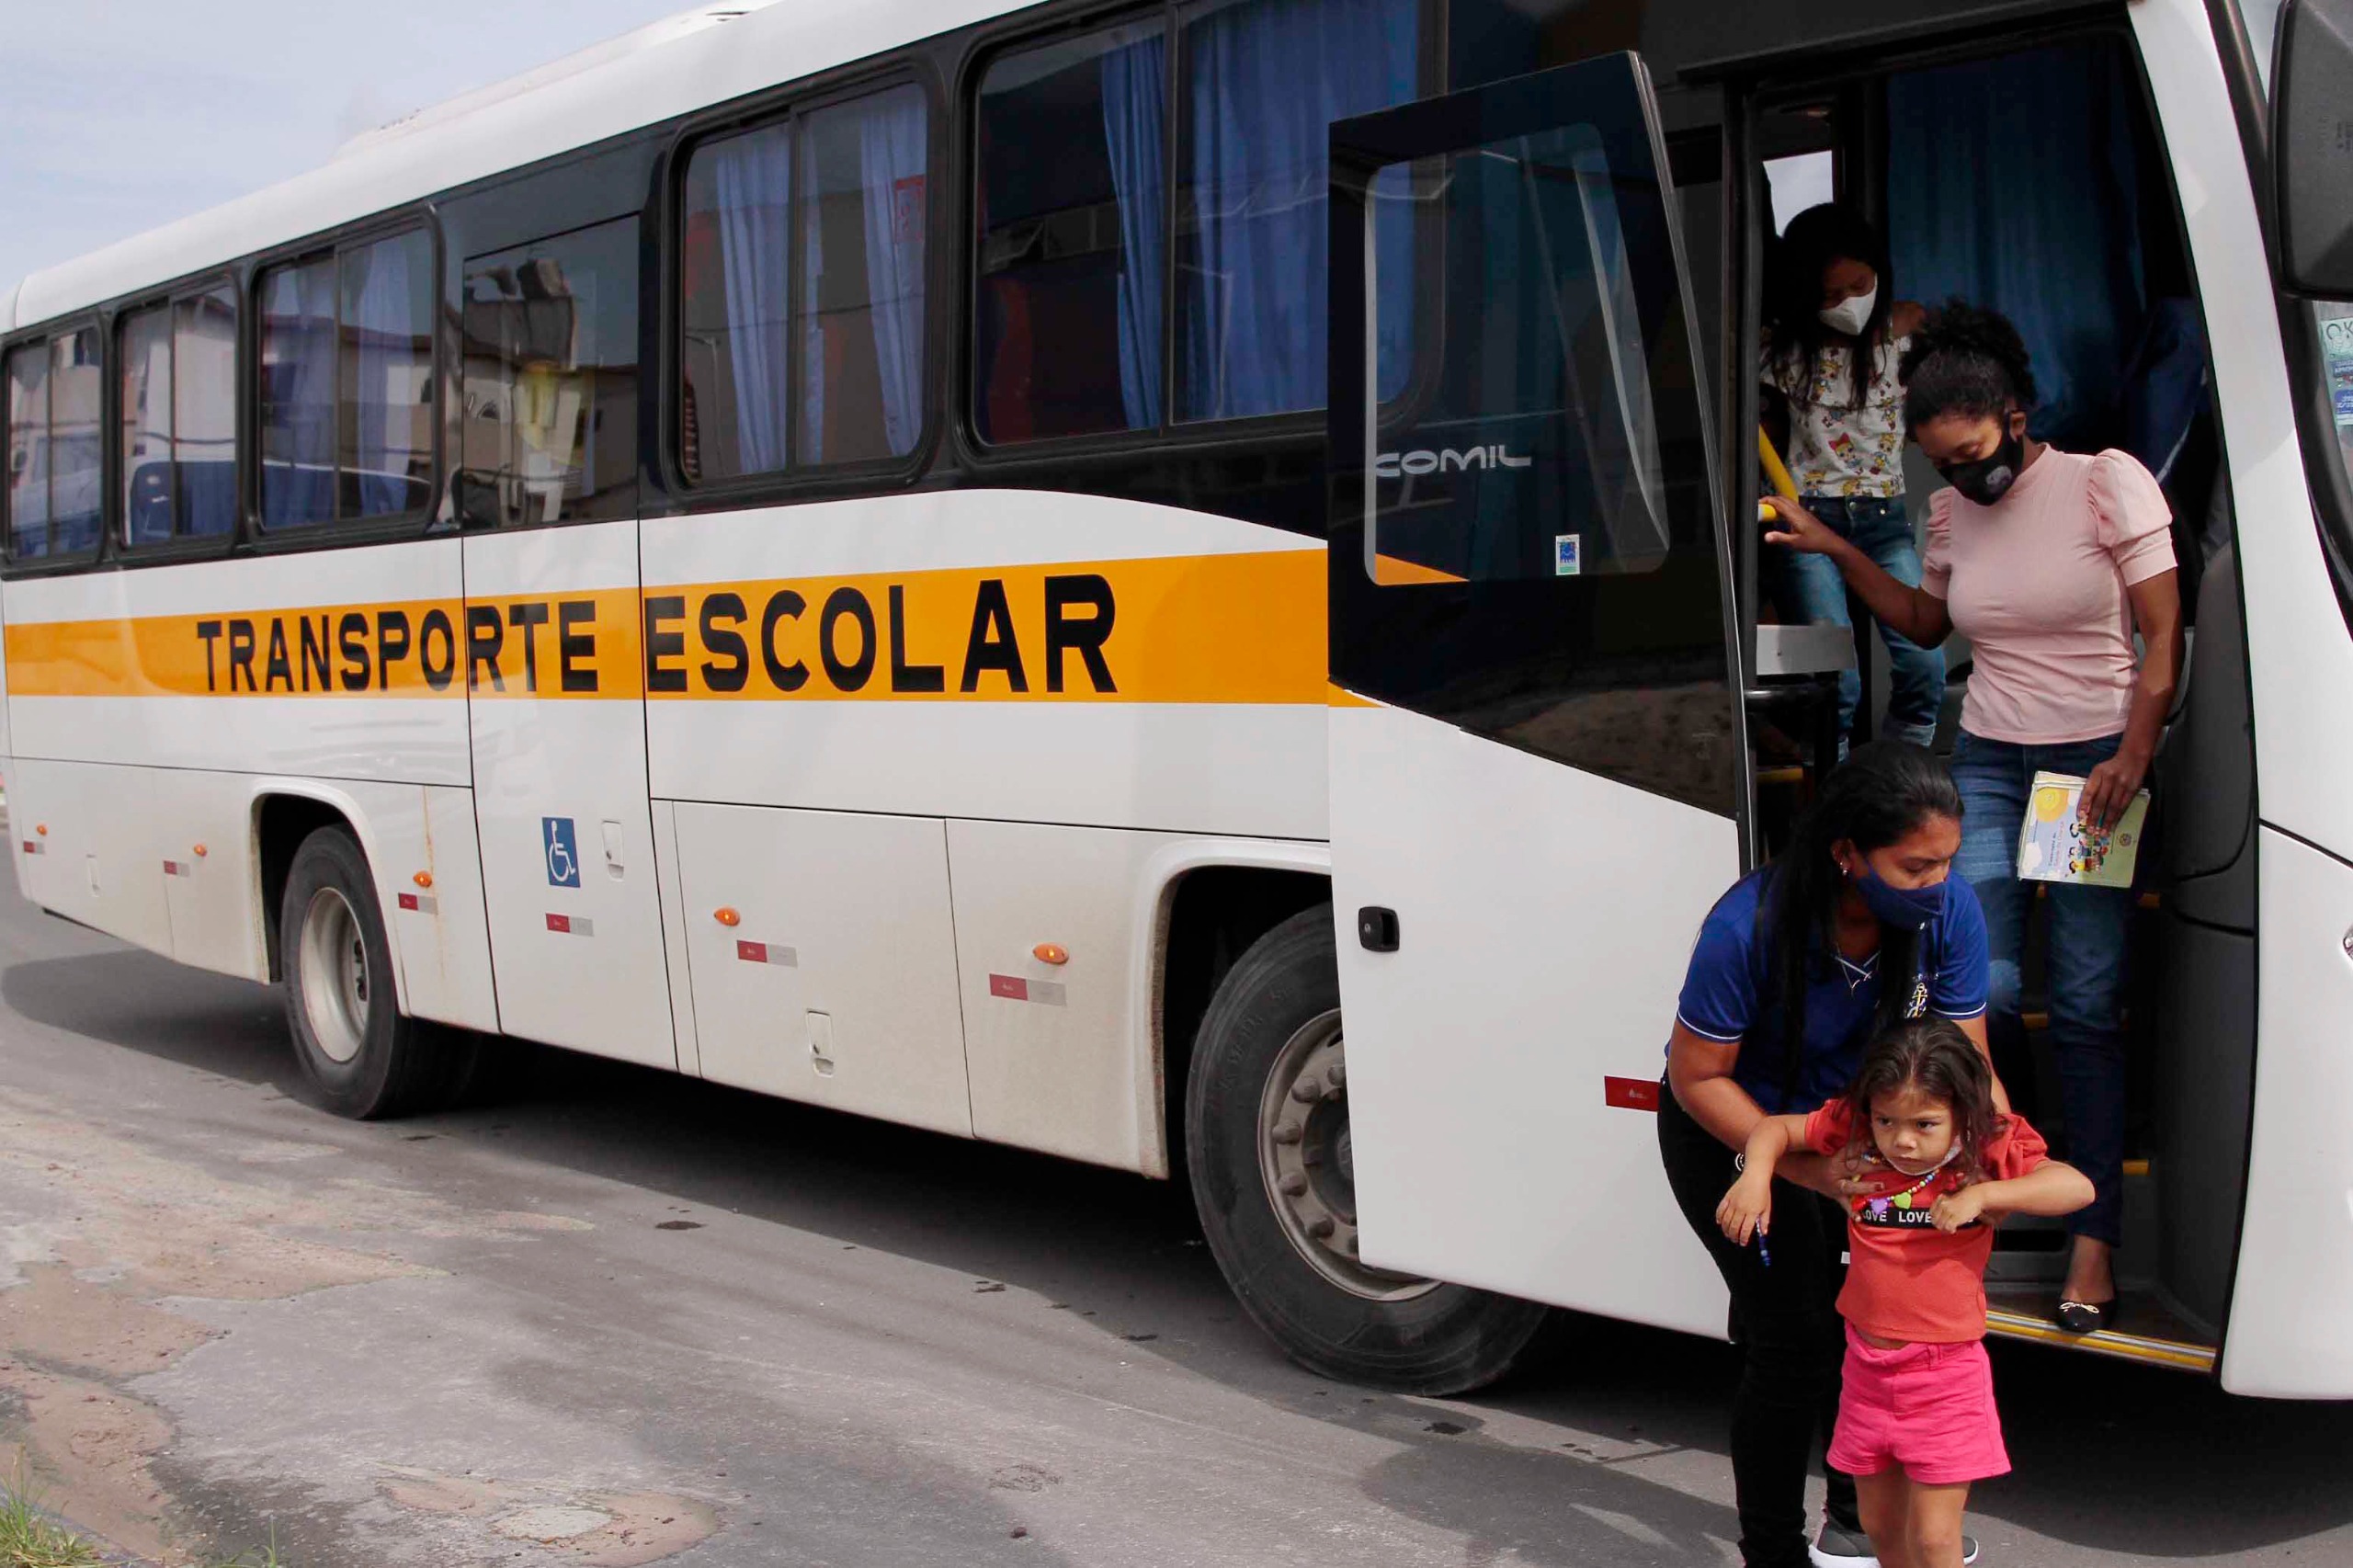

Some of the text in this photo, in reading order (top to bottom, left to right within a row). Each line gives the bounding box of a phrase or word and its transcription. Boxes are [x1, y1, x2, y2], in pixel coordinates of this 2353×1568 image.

[1376, 445, 1531, 477] COMIL
[197, 574, 1118, 693] TRANSPORTE ESCOLAR
[1898, 1210, 1931, 1223] LOVE
